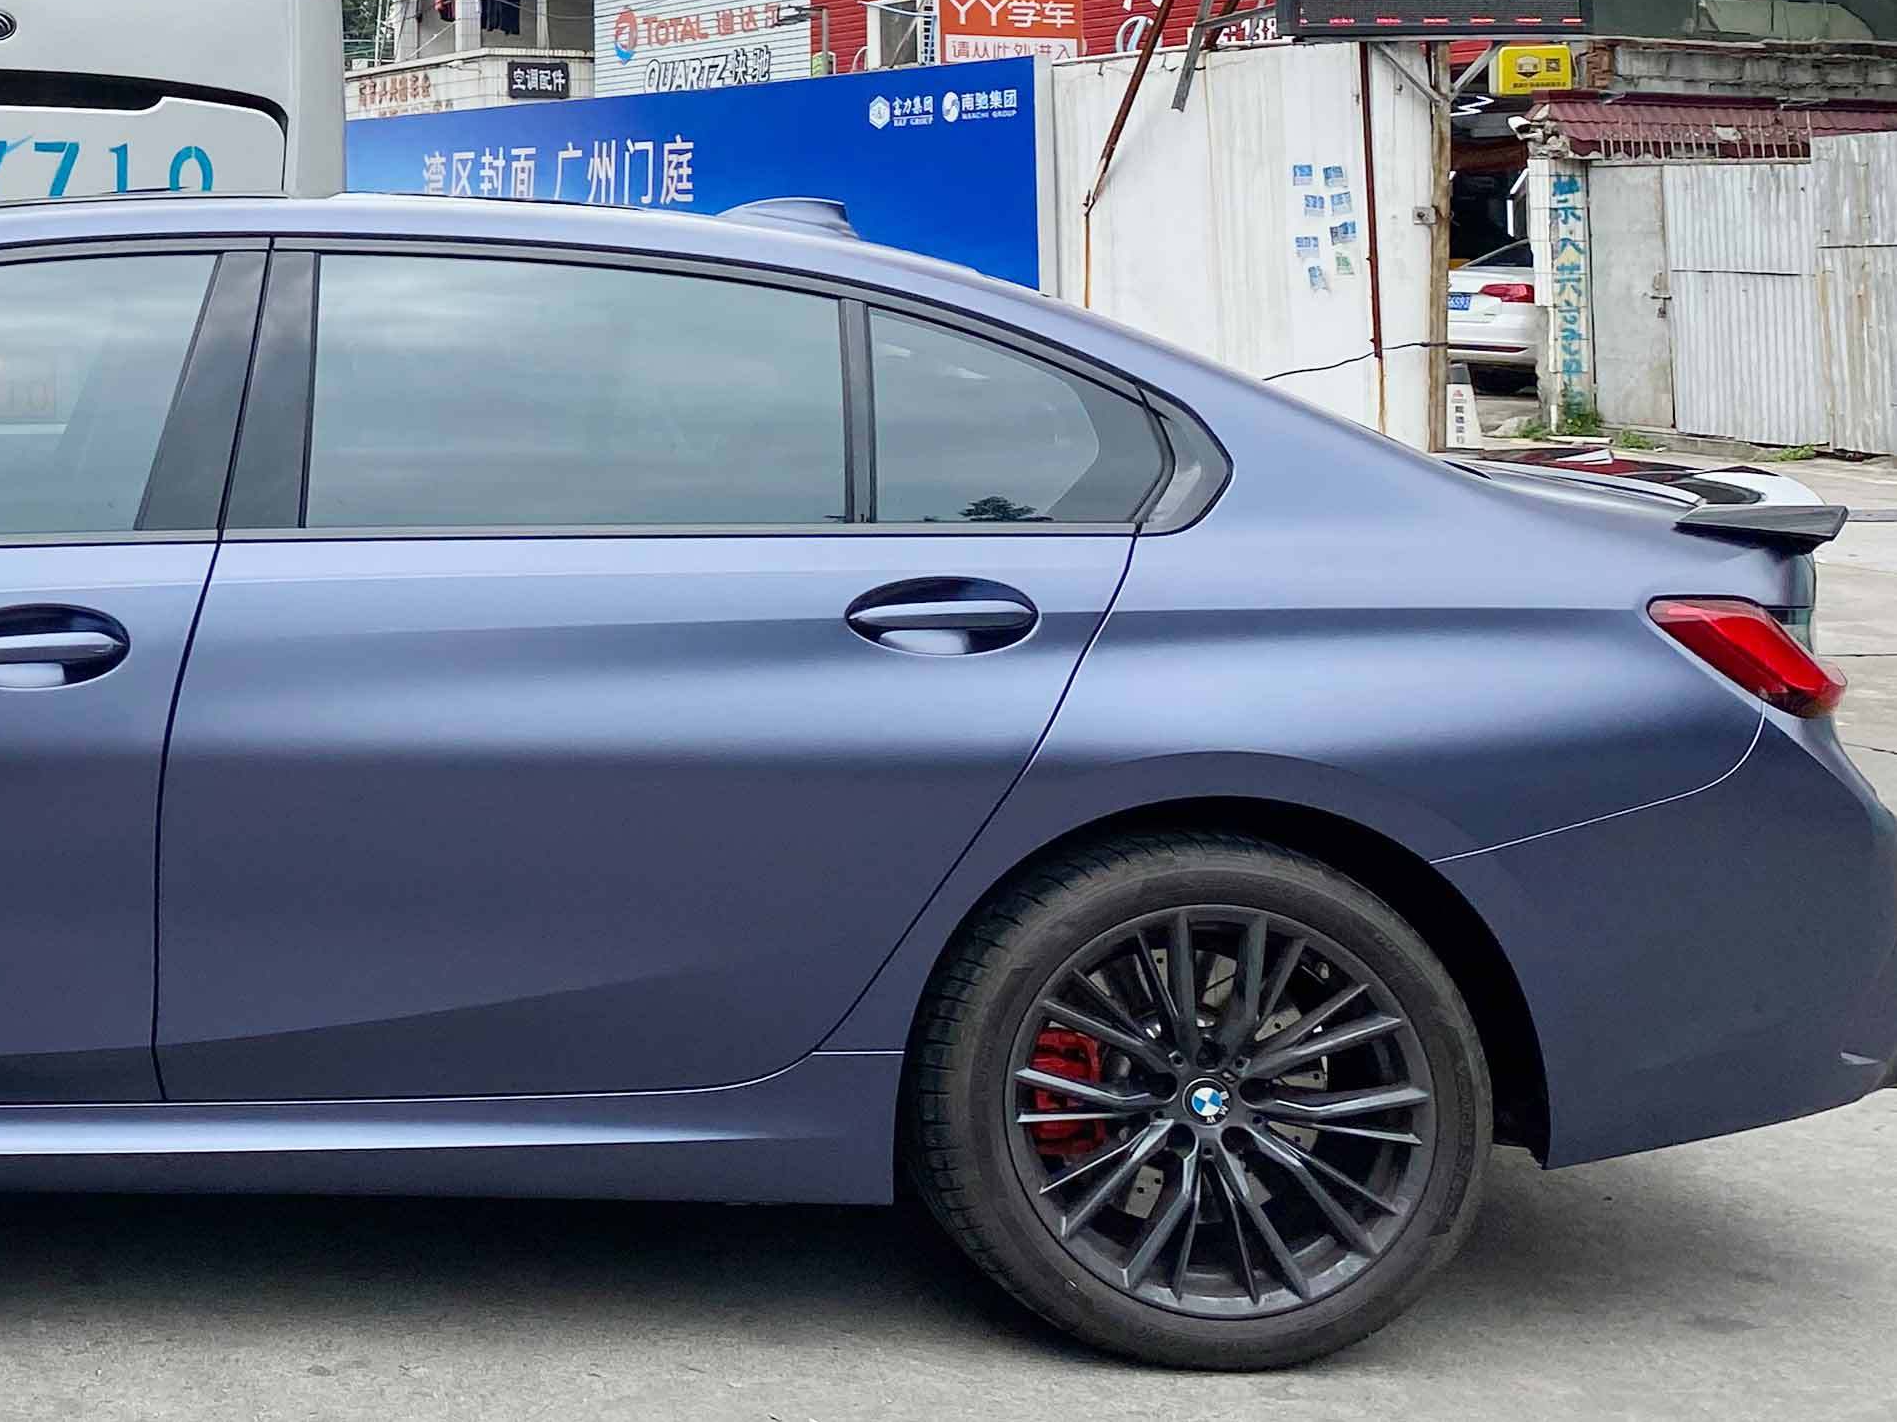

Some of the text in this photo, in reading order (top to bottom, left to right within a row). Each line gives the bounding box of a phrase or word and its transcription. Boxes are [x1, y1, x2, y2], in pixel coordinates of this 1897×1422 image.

[643, 14, 710, 47] TOTAL
[512, 68, 566, 91] 空调配件
[554, 134, 695, 205] 广州门庭
